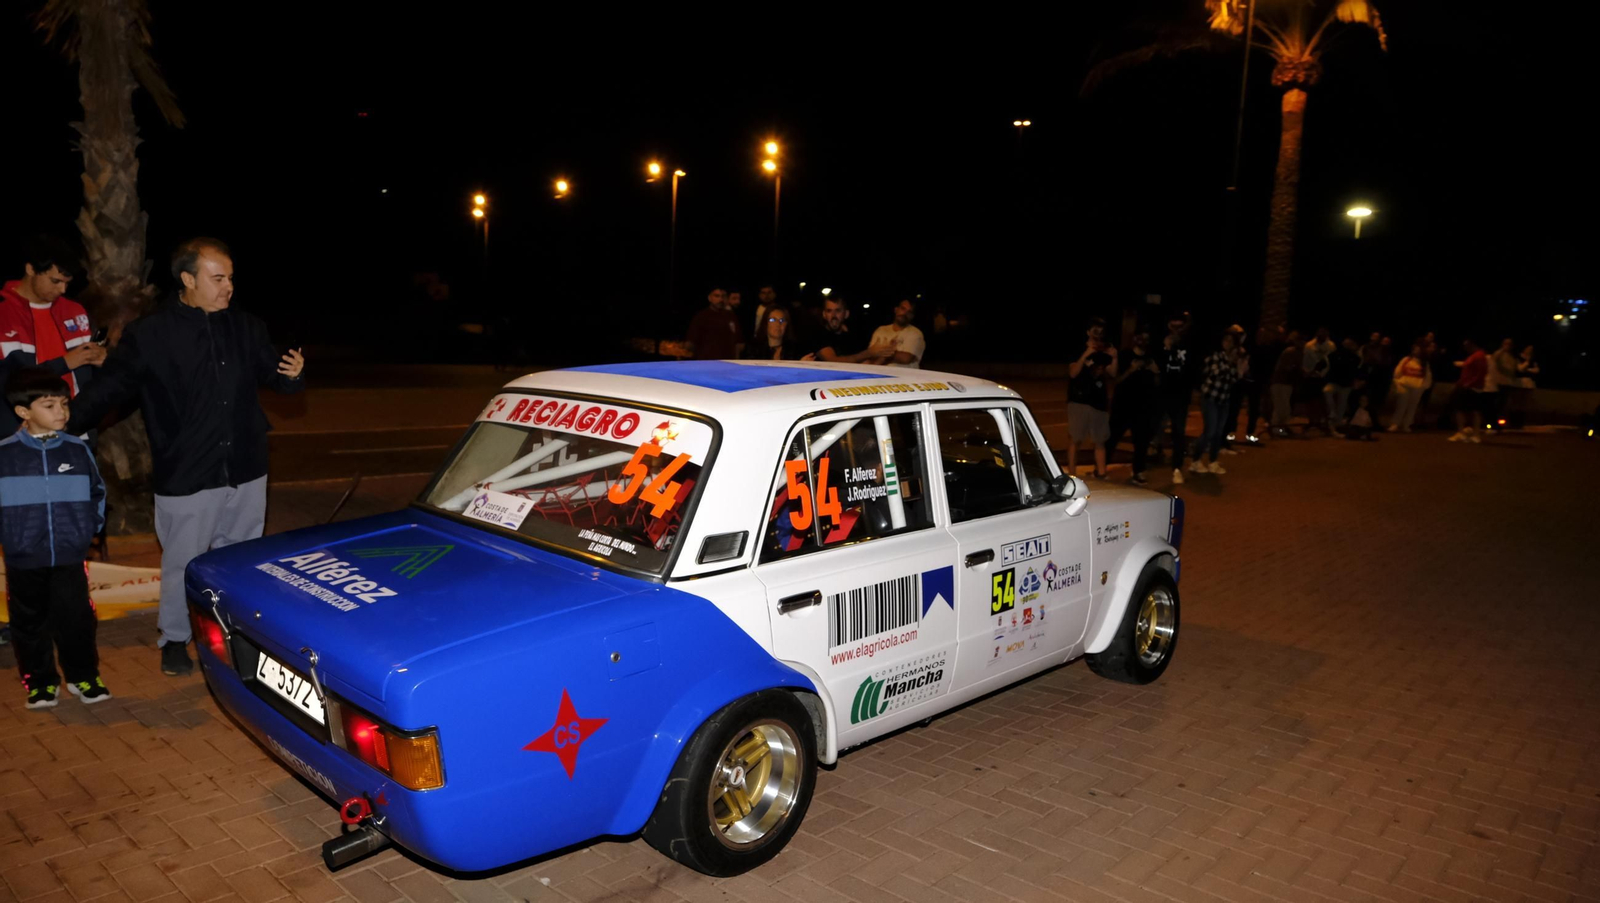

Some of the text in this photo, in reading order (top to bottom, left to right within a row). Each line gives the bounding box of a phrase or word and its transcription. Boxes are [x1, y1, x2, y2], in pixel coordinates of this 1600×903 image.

[506, 398, 640, 440] RECIAGRO
[608, 442, 692, 518] 54
[785, 457, 842, 530] 54
[485, 502, 501, 512] COSTA
[1003, 537, 1050, 564] SEAT
[278, 552, 398, 604] Alférez
[1052, 573, 1081, 591] ALMERÍA
[1058, 566, 1074, 576] COSTA
[992, 571, 1015, 612] 54
[830, 629, 918, 666] www.elagricola.com
[875, 650, 947, 678] CONTENEDORES
[886, 659, 946, 684] HERMANOS
[884, 669, 944, 700] Mancha
[553, 721, 580, 749] CS
